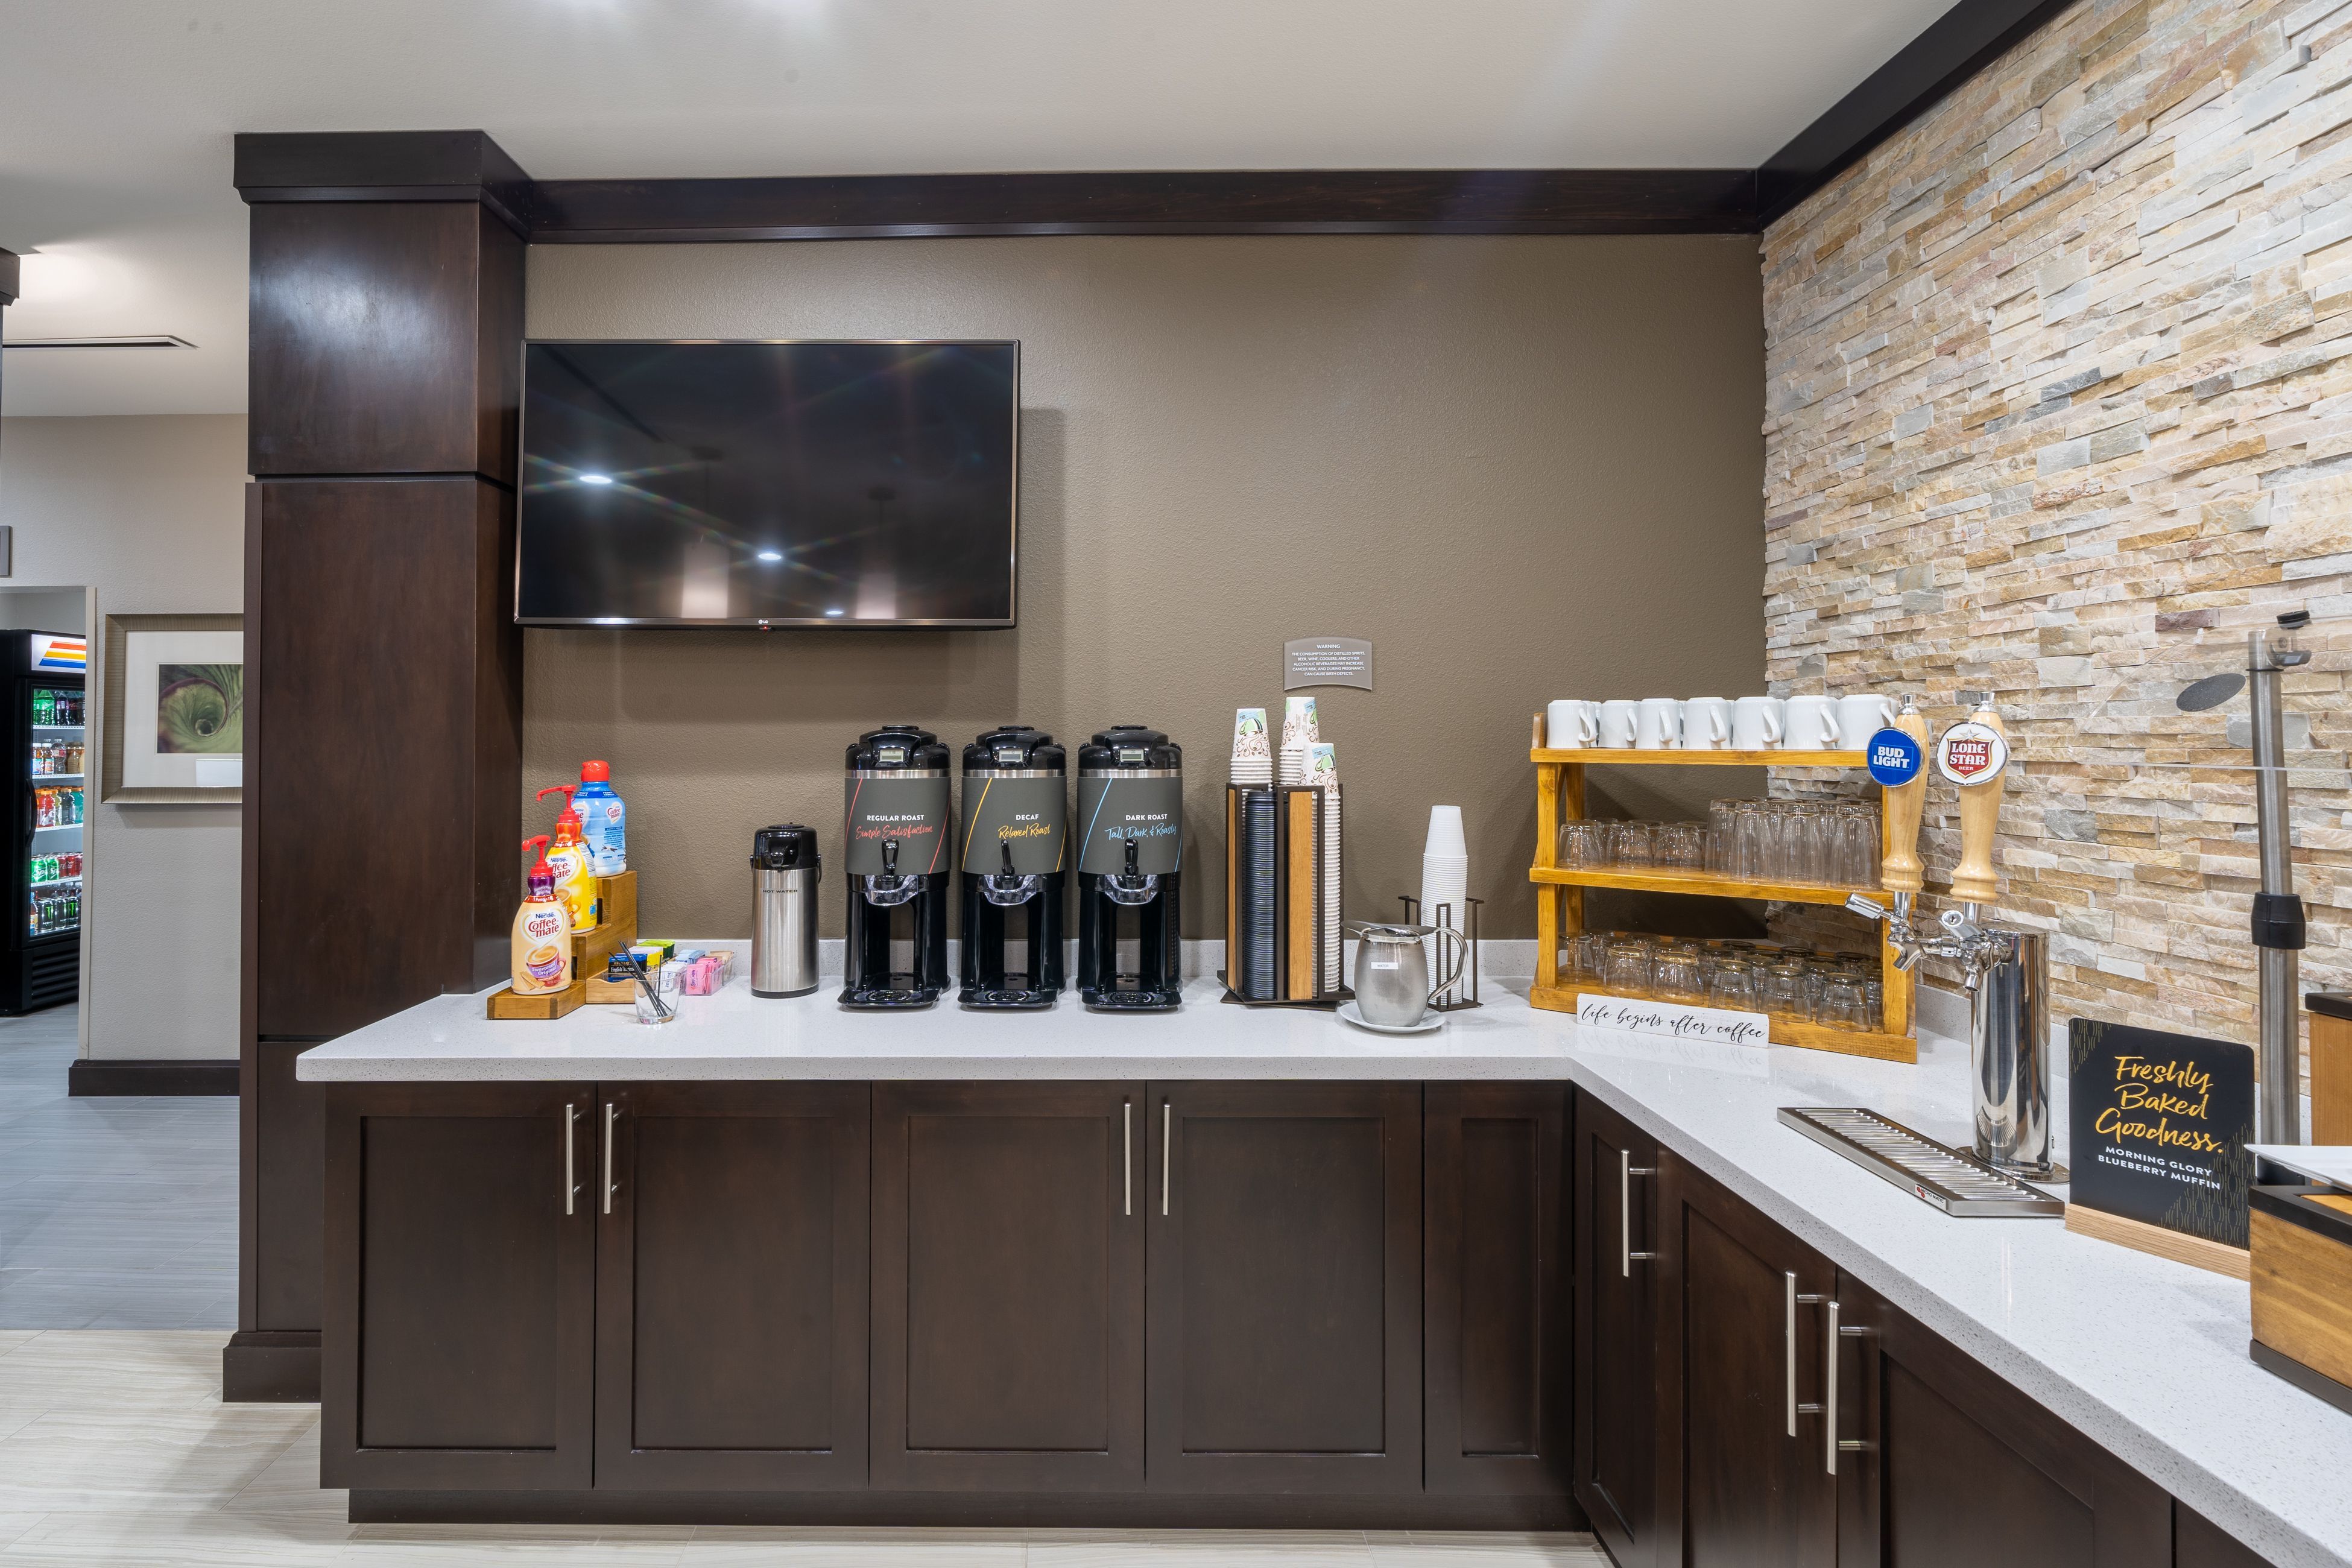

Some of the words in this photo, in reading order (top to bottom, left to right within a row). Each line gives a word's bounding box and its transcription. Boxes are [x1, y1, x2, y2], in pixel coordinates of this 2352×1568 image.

[1877, 746, 1905, 758] BUD
[1951, 742, 1986, 754] LONE
[1873, 755, 1910, 768] LIGHT
[1949, 754, 1986, 765] STAR
[855, 826, 881, 839] Simple
[882, 823, 933, 839] Satisfaction
[998, 825, 1029, 839] Relaxed
[1029, 823, 1051, 837] Roast
[1149, 825, 1154, 836] &
[1155, 823, 1177, 837] Roasty
[551, 862, 567, 873] ffee
[528, 918, 557, 932] Coffee
[536, 925, 559, 937] mate
[531, 961, 556, 972] Sweetened
[538, 966, 557, 975] Original
[1581, 1004, 1612, 1025] life
[1616, 1008, 1663, 1029] begins
[1670, 1016, 1712, 1035] after
[1717, 1022, 1766, 1043] coffee
[2114, 1055, 2214, 1094] Freshly
[2114, 1083, 2208, 1119] Baked
[2095, 1107, 2224, 1154] Goodness.
[2105, 1146, 2165, 1166] MORNING
[2169, 1161, 2213, 1177] GLORY
[2098, 1154, 2167, 1177] BLUEBERRY
[2170, 1172, 2221, 1190] MUFFIN
